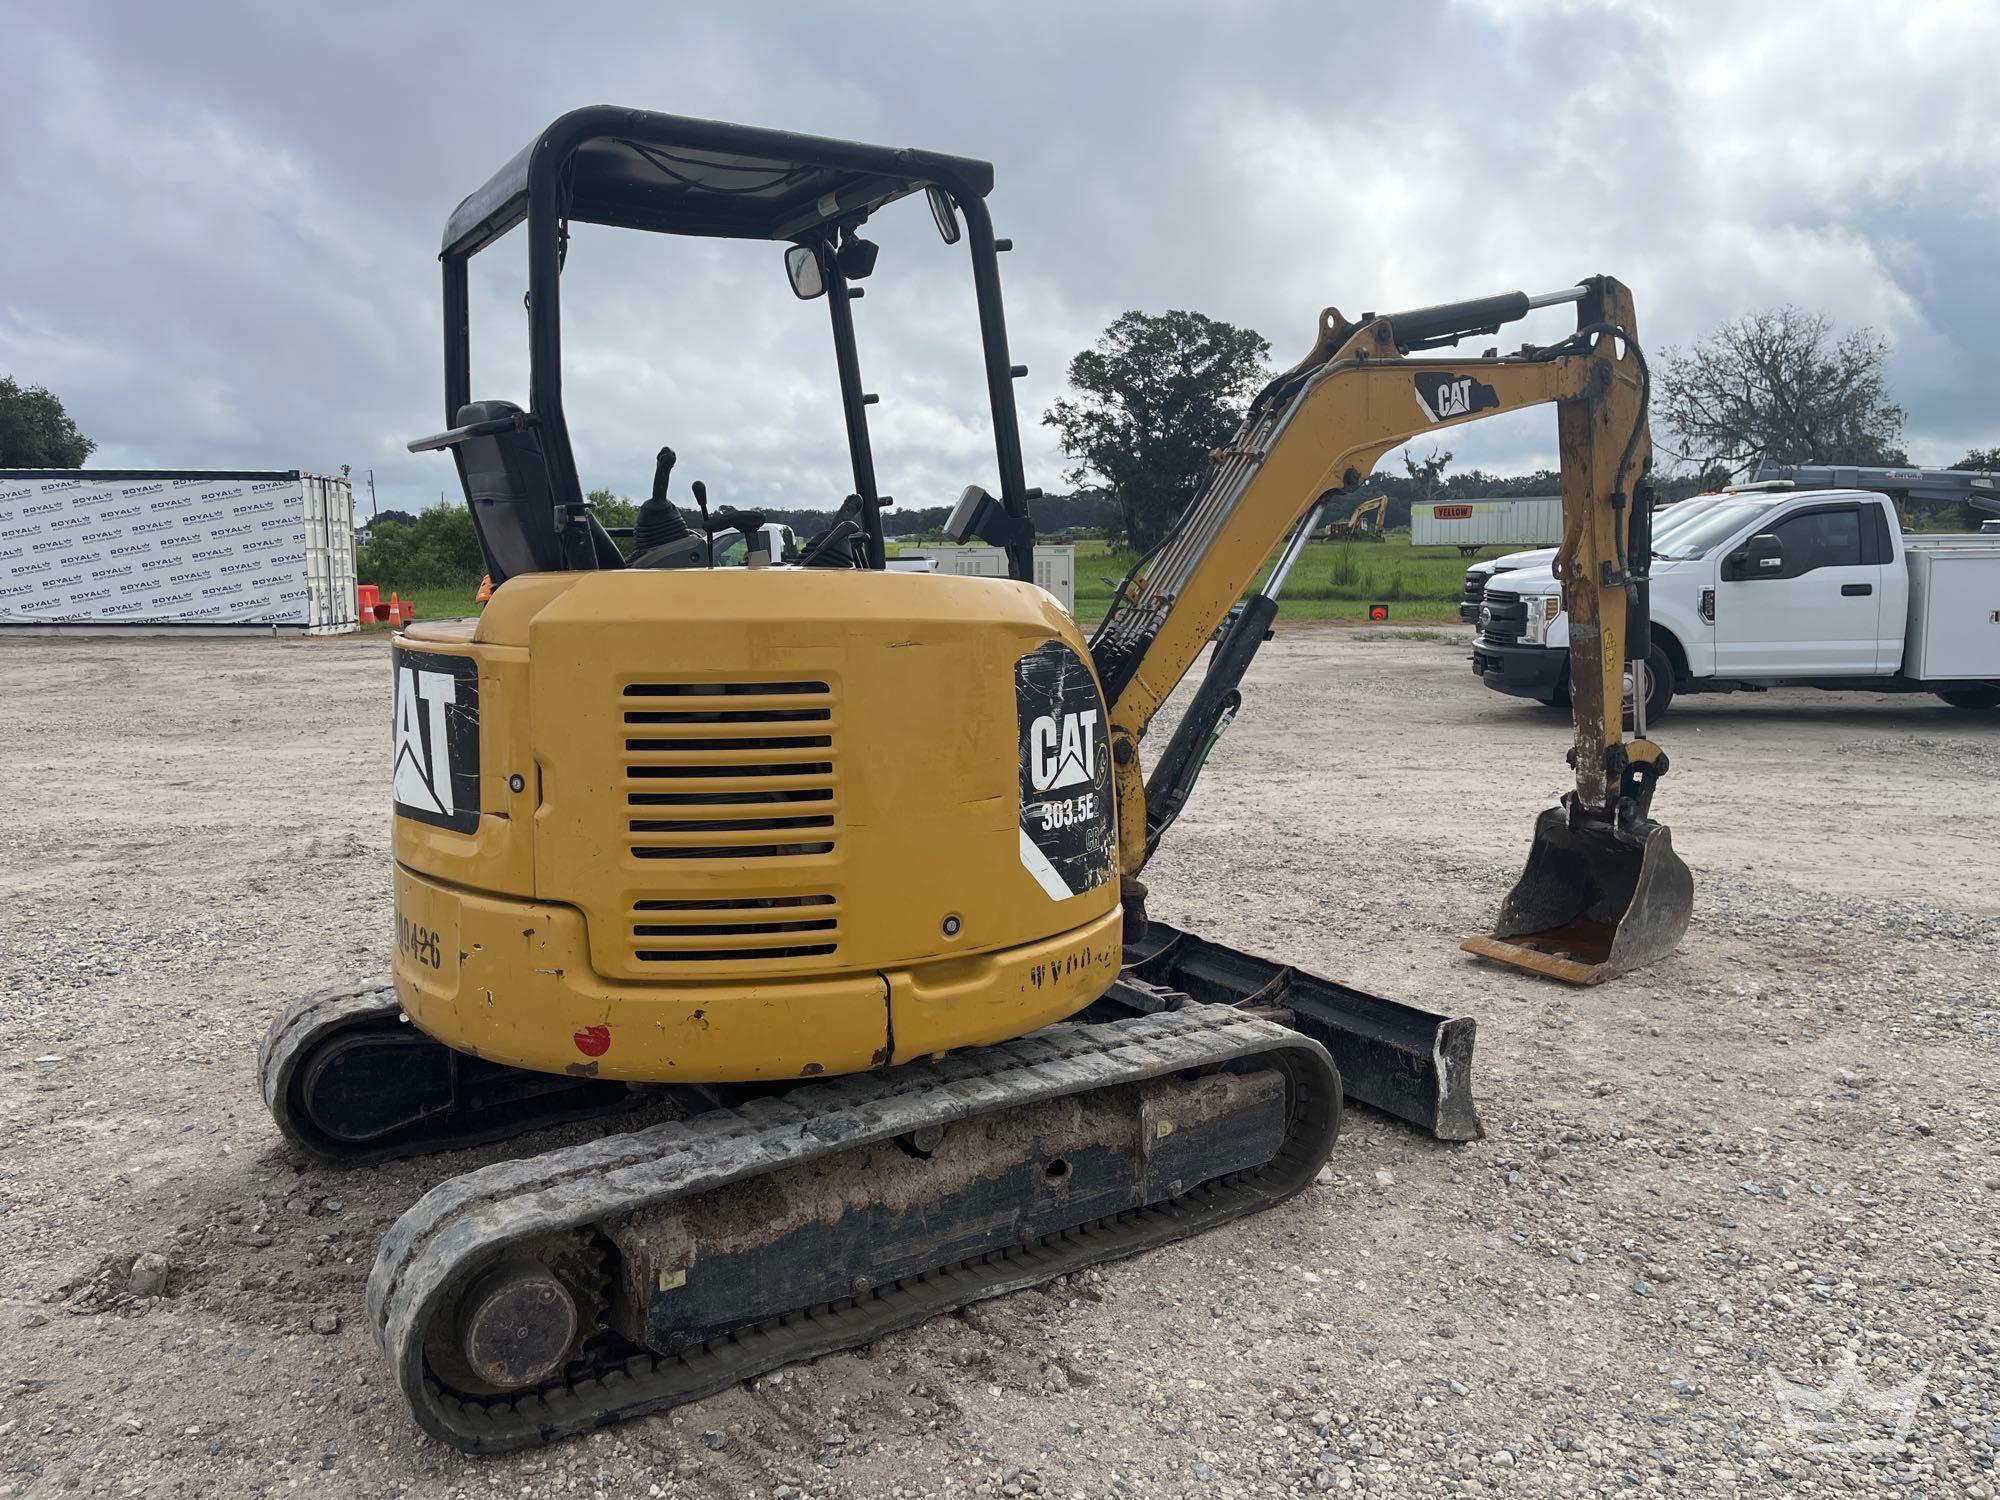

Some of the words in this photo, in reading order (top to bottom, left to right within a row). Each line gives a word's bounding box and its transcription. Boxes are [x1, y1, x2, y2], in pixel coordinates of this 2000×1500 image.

[1438, 379, 1472, 417] CAT
[41, 481, 73, 491] ROYAL
[122, 485, 154, 495] ROYAL
[252, 481, 284, 491] ROYAL
[0, 490, 22, 500] OYAL
[72, 494, 104, 504] ROYAL
[201, 490, 233, 500] ROYAL
[283, 496, 303, 504] ROY
[22, 504, 54, 514] ROYAL
[151, 499, 183, 509] ROYAL
[233, 503, 265, 513] ROYAL
[100, 508, 132, 518] ROYAL
[182, 512, 214, 522] ROYAL
[1438, 507, 1468, 517] YELLOW
[50, 517, 82, 527] ROYAL
[132, 522, 164, 532] ROYAL
[261, 517, 293, 527] ROYAL
[1, 527, 33, 537] ROYAL
[82, 531, 114, 541] ROYAL
[211, 526, 243, 536] ROYAL
[32, 540, 64, 550] ROYAL
[160, 535, 192, 545] ROYAL
[242, 540, 274, 550] ROYAL
[110, 545, 142, 555] ROYAL
[192, 549, 224, 559] ROYAL
[60, 554, 92, 564] ROYAL
[142, 558, 174, 568] ROYAL
[270, 553, 302, 563] ROYAL
[11, 563, 43, 573] ROYAL
[92, 567, 124, 577] ROYAL
[220, 562, 252, 572] ROYAL
[42, 577, 74, 587] ROYAL
[170, 572, 202, 582] ROYAL
[252, 576, 284, 586] ROYAL
[0, 586, 24, 595] OYAL
[120, 581, 152, 591] ROYAL
[202, 585, 234, 595] ROYAL
[70, 590, 102, 600] ROYAL
[152, 594, 184, 604] ROYAL
[20, 600, 52, 610] ROYAL
[101, 603, 133, 613] ROYAL
[230, 598, 262, 608] ROYAL
[180, 608, 212, 618] ROYAL
[261, 611, 293, 621] ROYAL
[393, 666, 457, 817] AT
[1031, 709, 1097, 791] CAT
